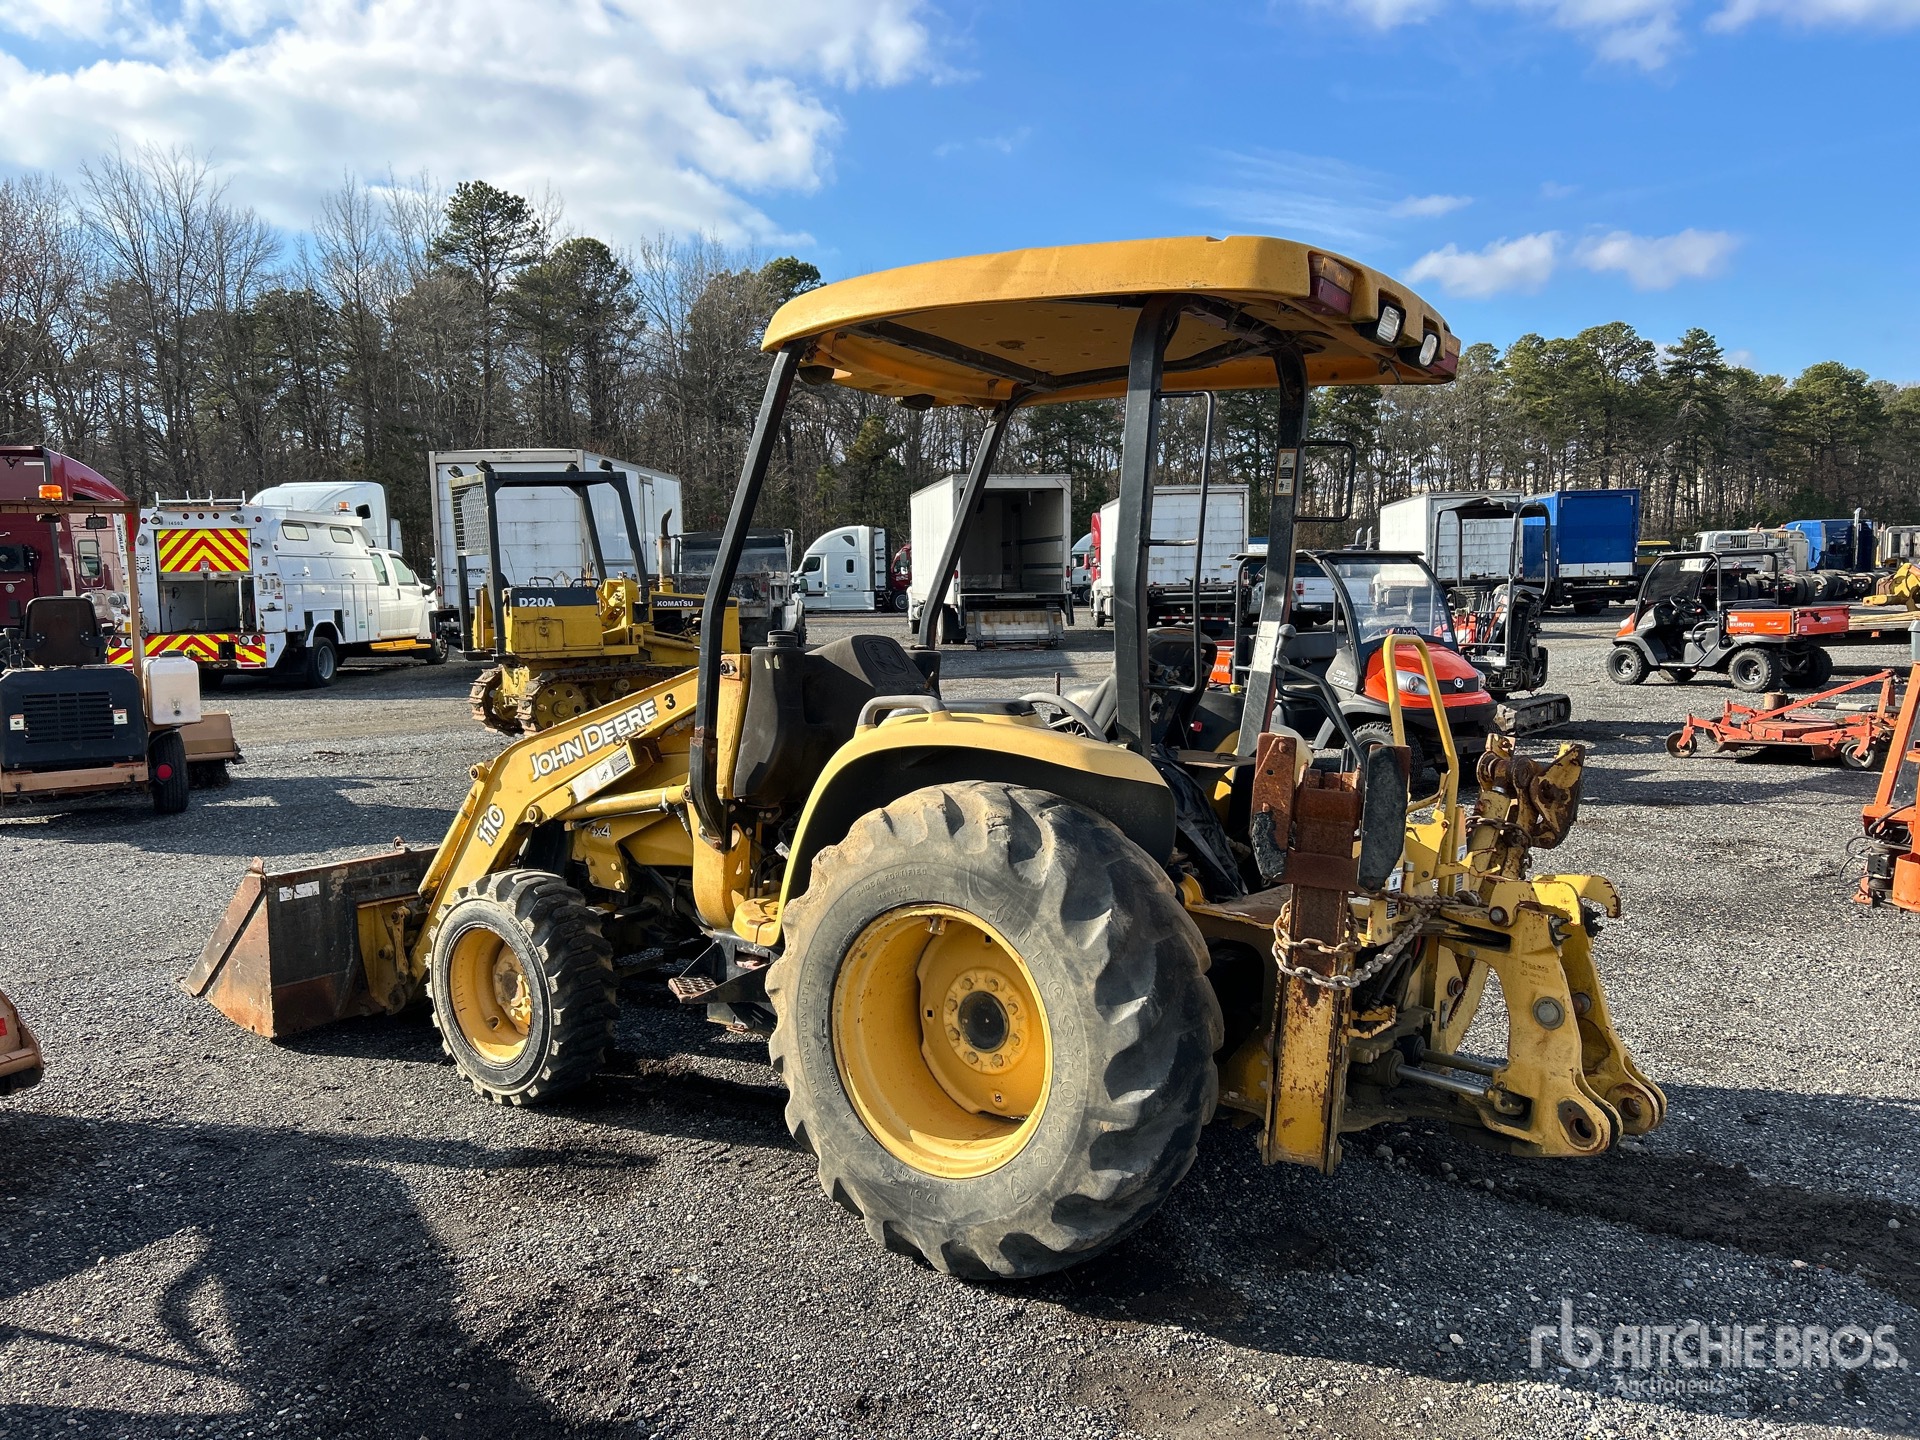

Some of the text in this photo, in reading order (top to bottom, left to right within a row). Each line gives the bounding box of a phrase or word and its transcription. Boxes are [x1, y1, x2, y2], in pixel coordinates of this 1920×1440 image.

[519, 597, 556, 608] D20A
[664, 693, 676, 710] 3
[530, 736, 585, 782] JOHN
[580, 698, 658, 754] DEERE
[477, 803, 505, 847] 110
[586, 821, 611, 838] 4x4
[884, 868, 928, 882] FORTIFIED
